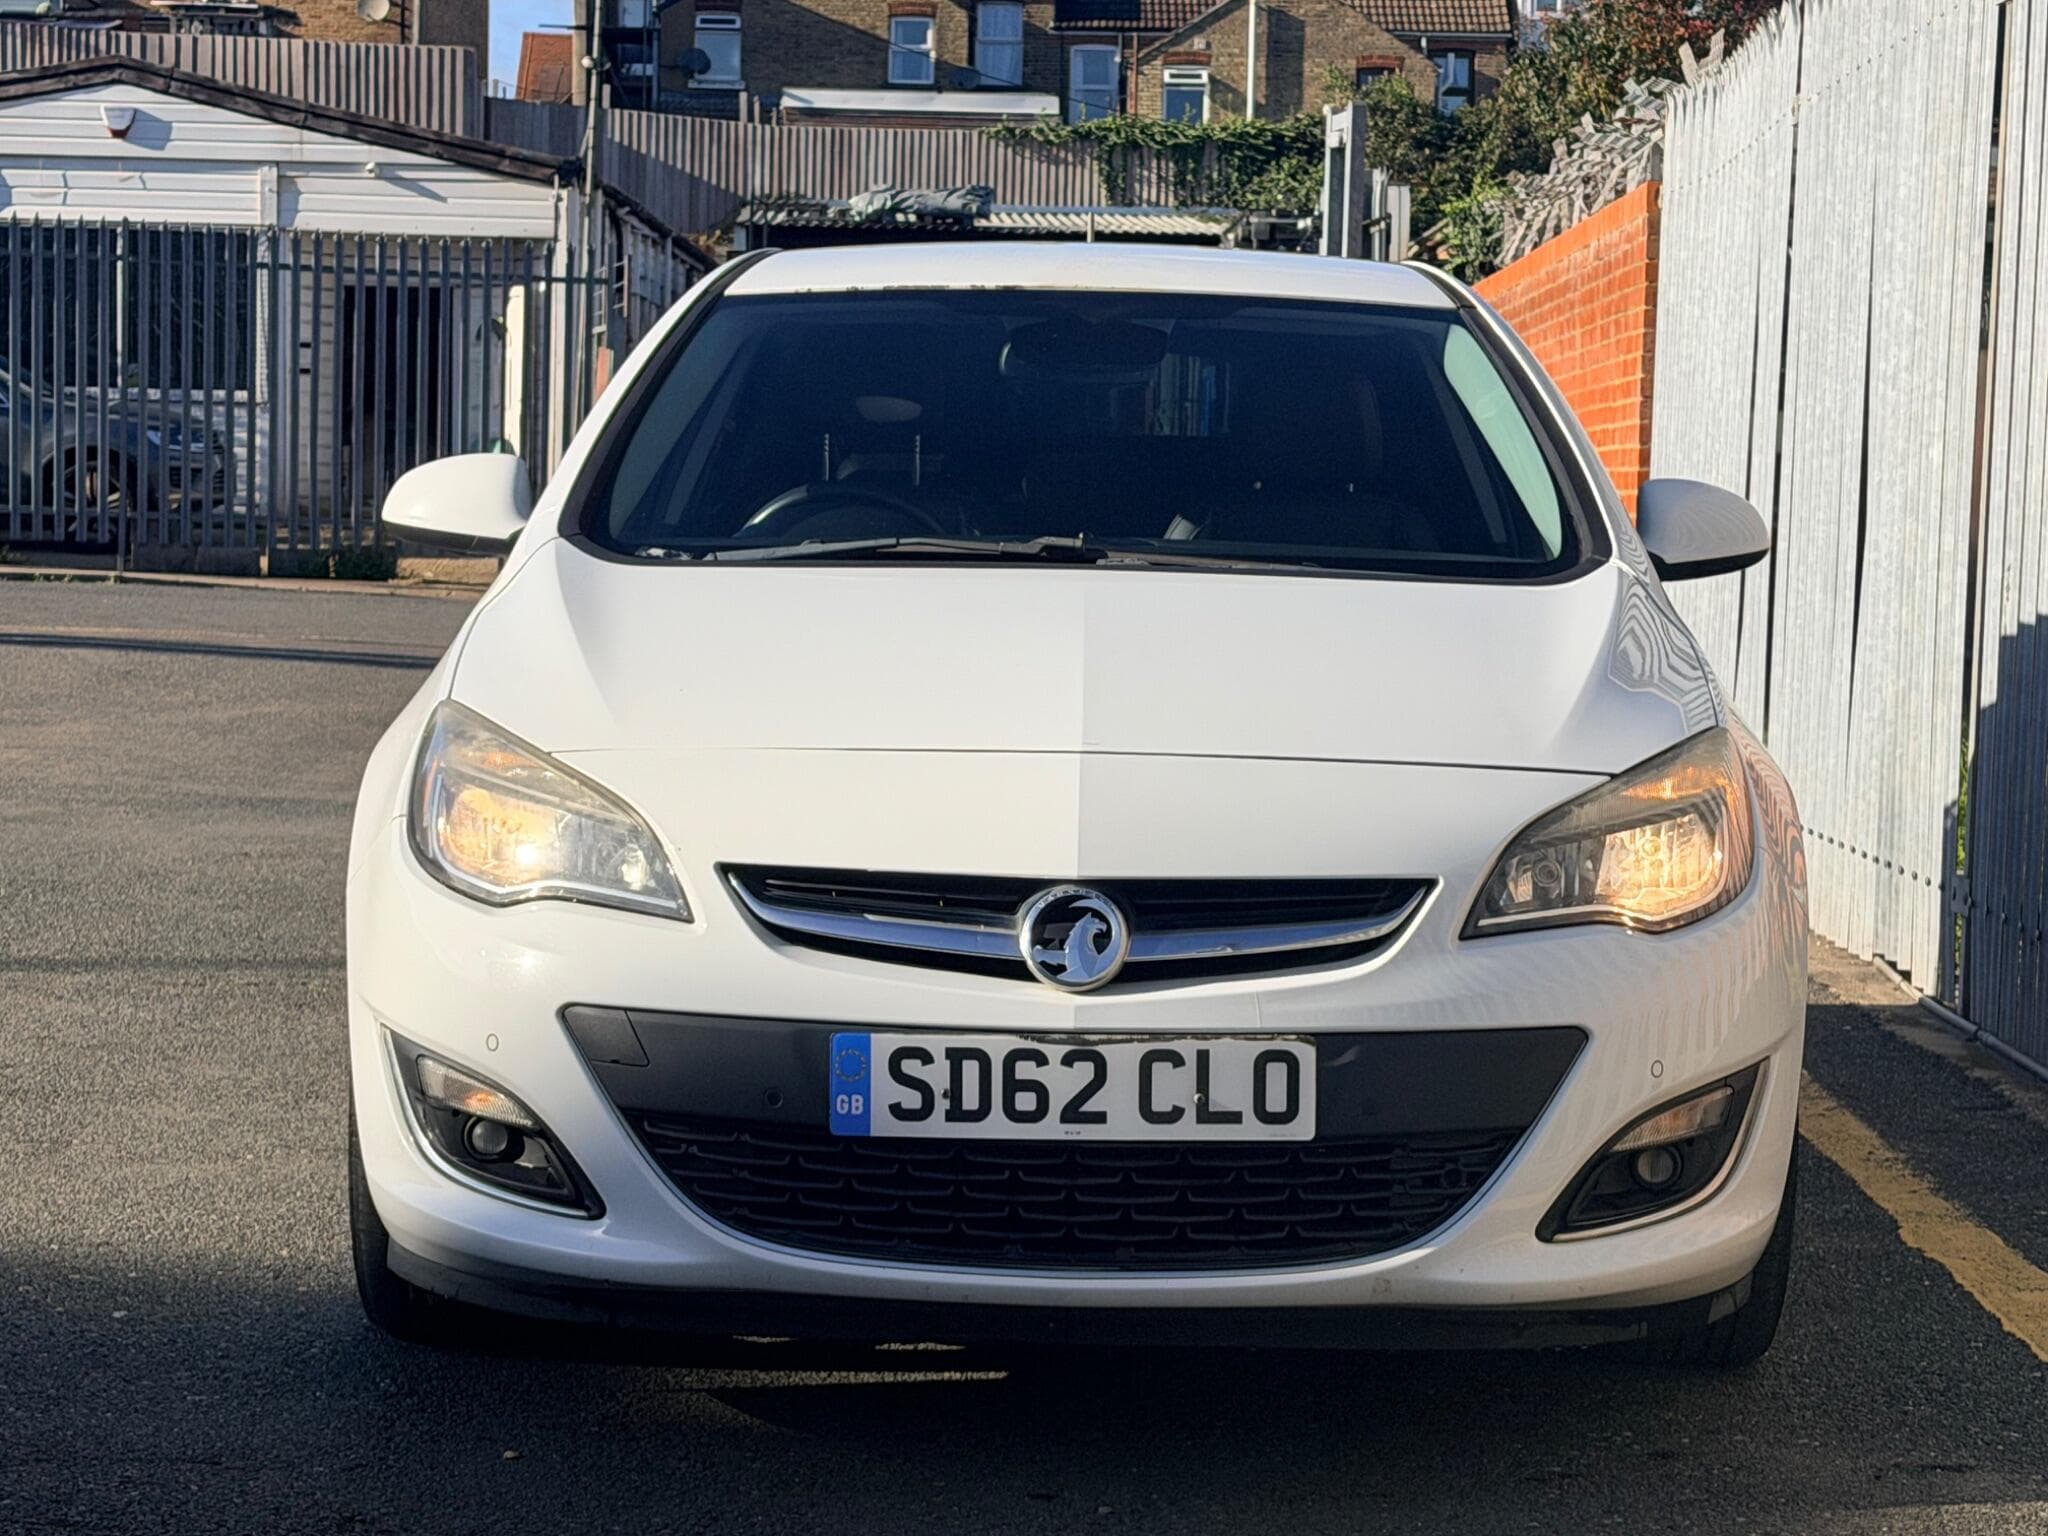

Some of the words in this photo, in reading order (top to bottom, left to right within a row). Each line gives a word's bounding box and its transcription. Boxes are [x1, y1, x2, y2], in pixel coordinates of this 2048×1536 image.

[836, 1094, 864, 1115] GB
[887, 1046, 1108, 1125] SD62
[1138, 1048, 1301, 1126] CLO
